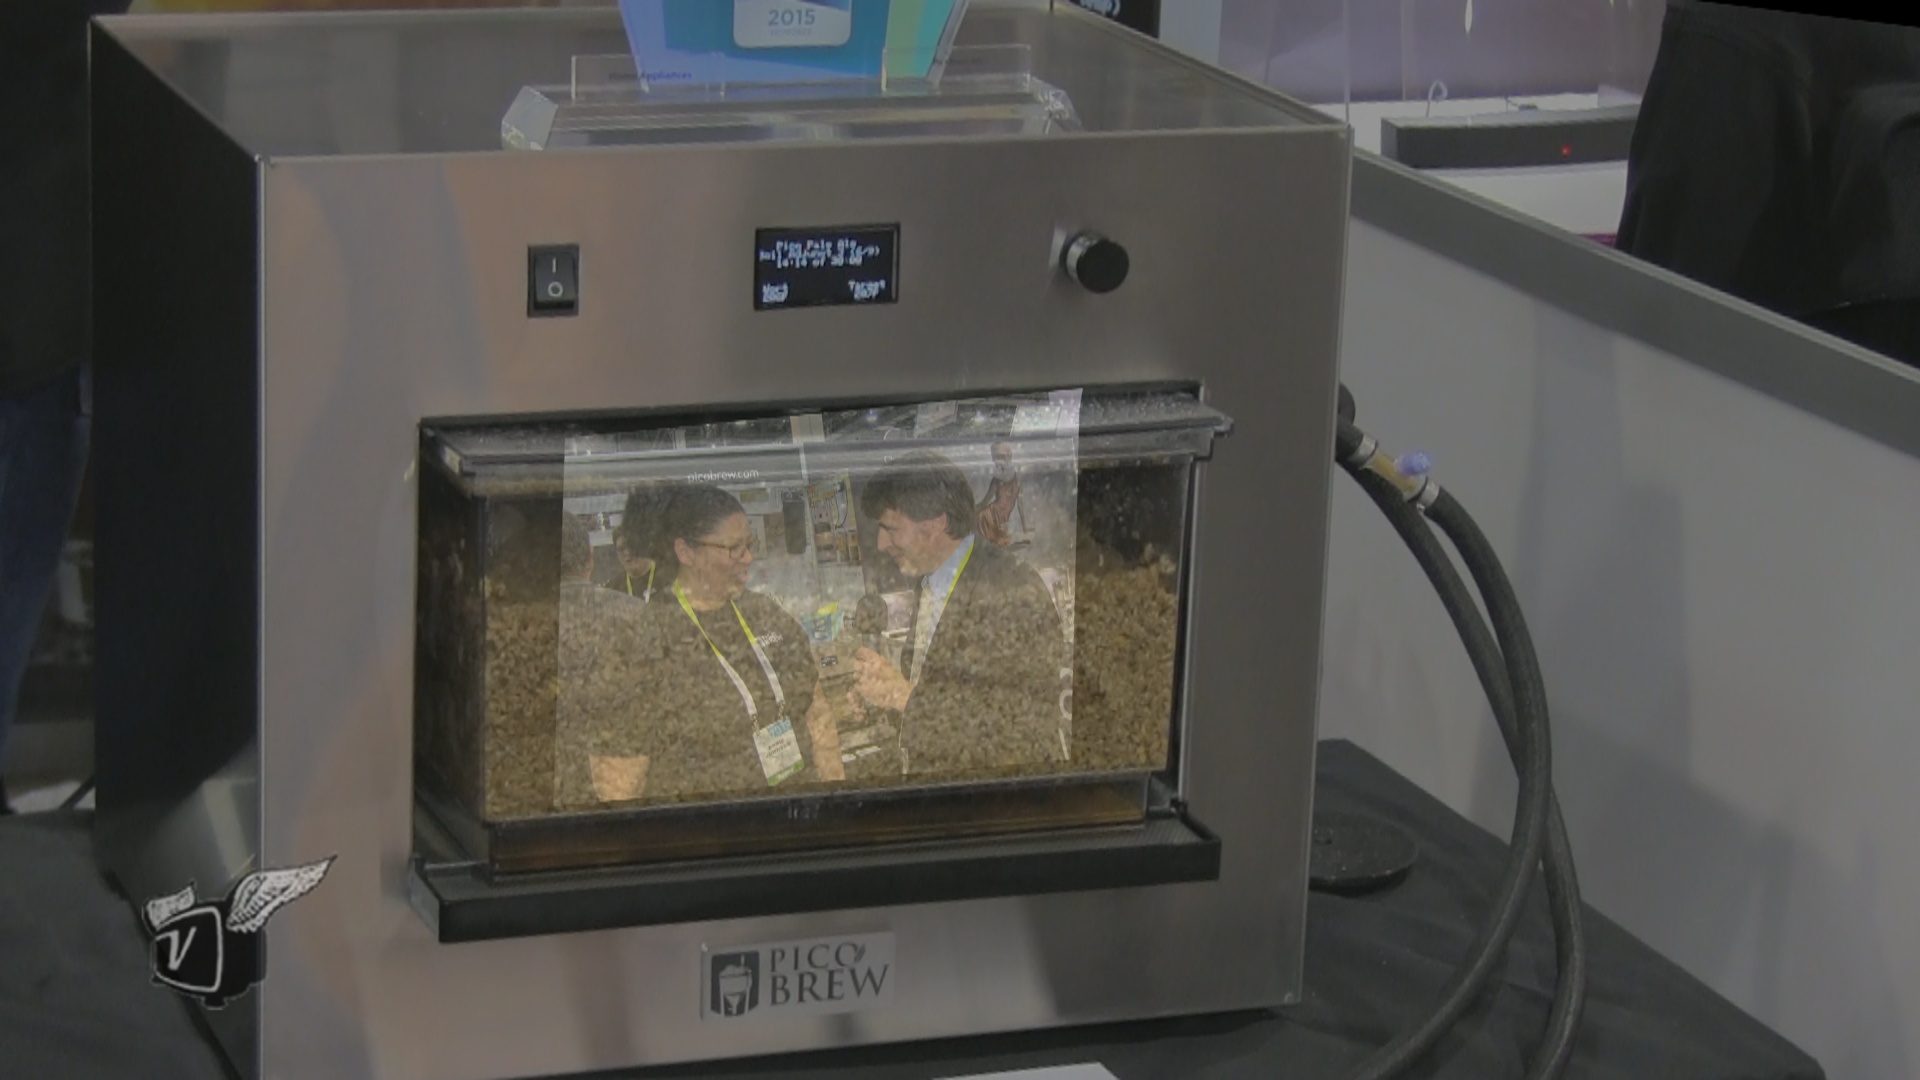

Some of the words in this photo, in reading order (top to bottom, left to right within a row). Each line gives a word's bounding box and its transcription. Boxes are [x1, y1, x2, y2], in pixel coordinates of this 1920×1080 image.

[768, 9, 816, 26] 2015
[640, 70, 692, 81] Appliances
[687, 470, 759, 483] picobrew.com
[770, 942, 866, 973] PICO
[769, 964, 890, 1006] BREW
